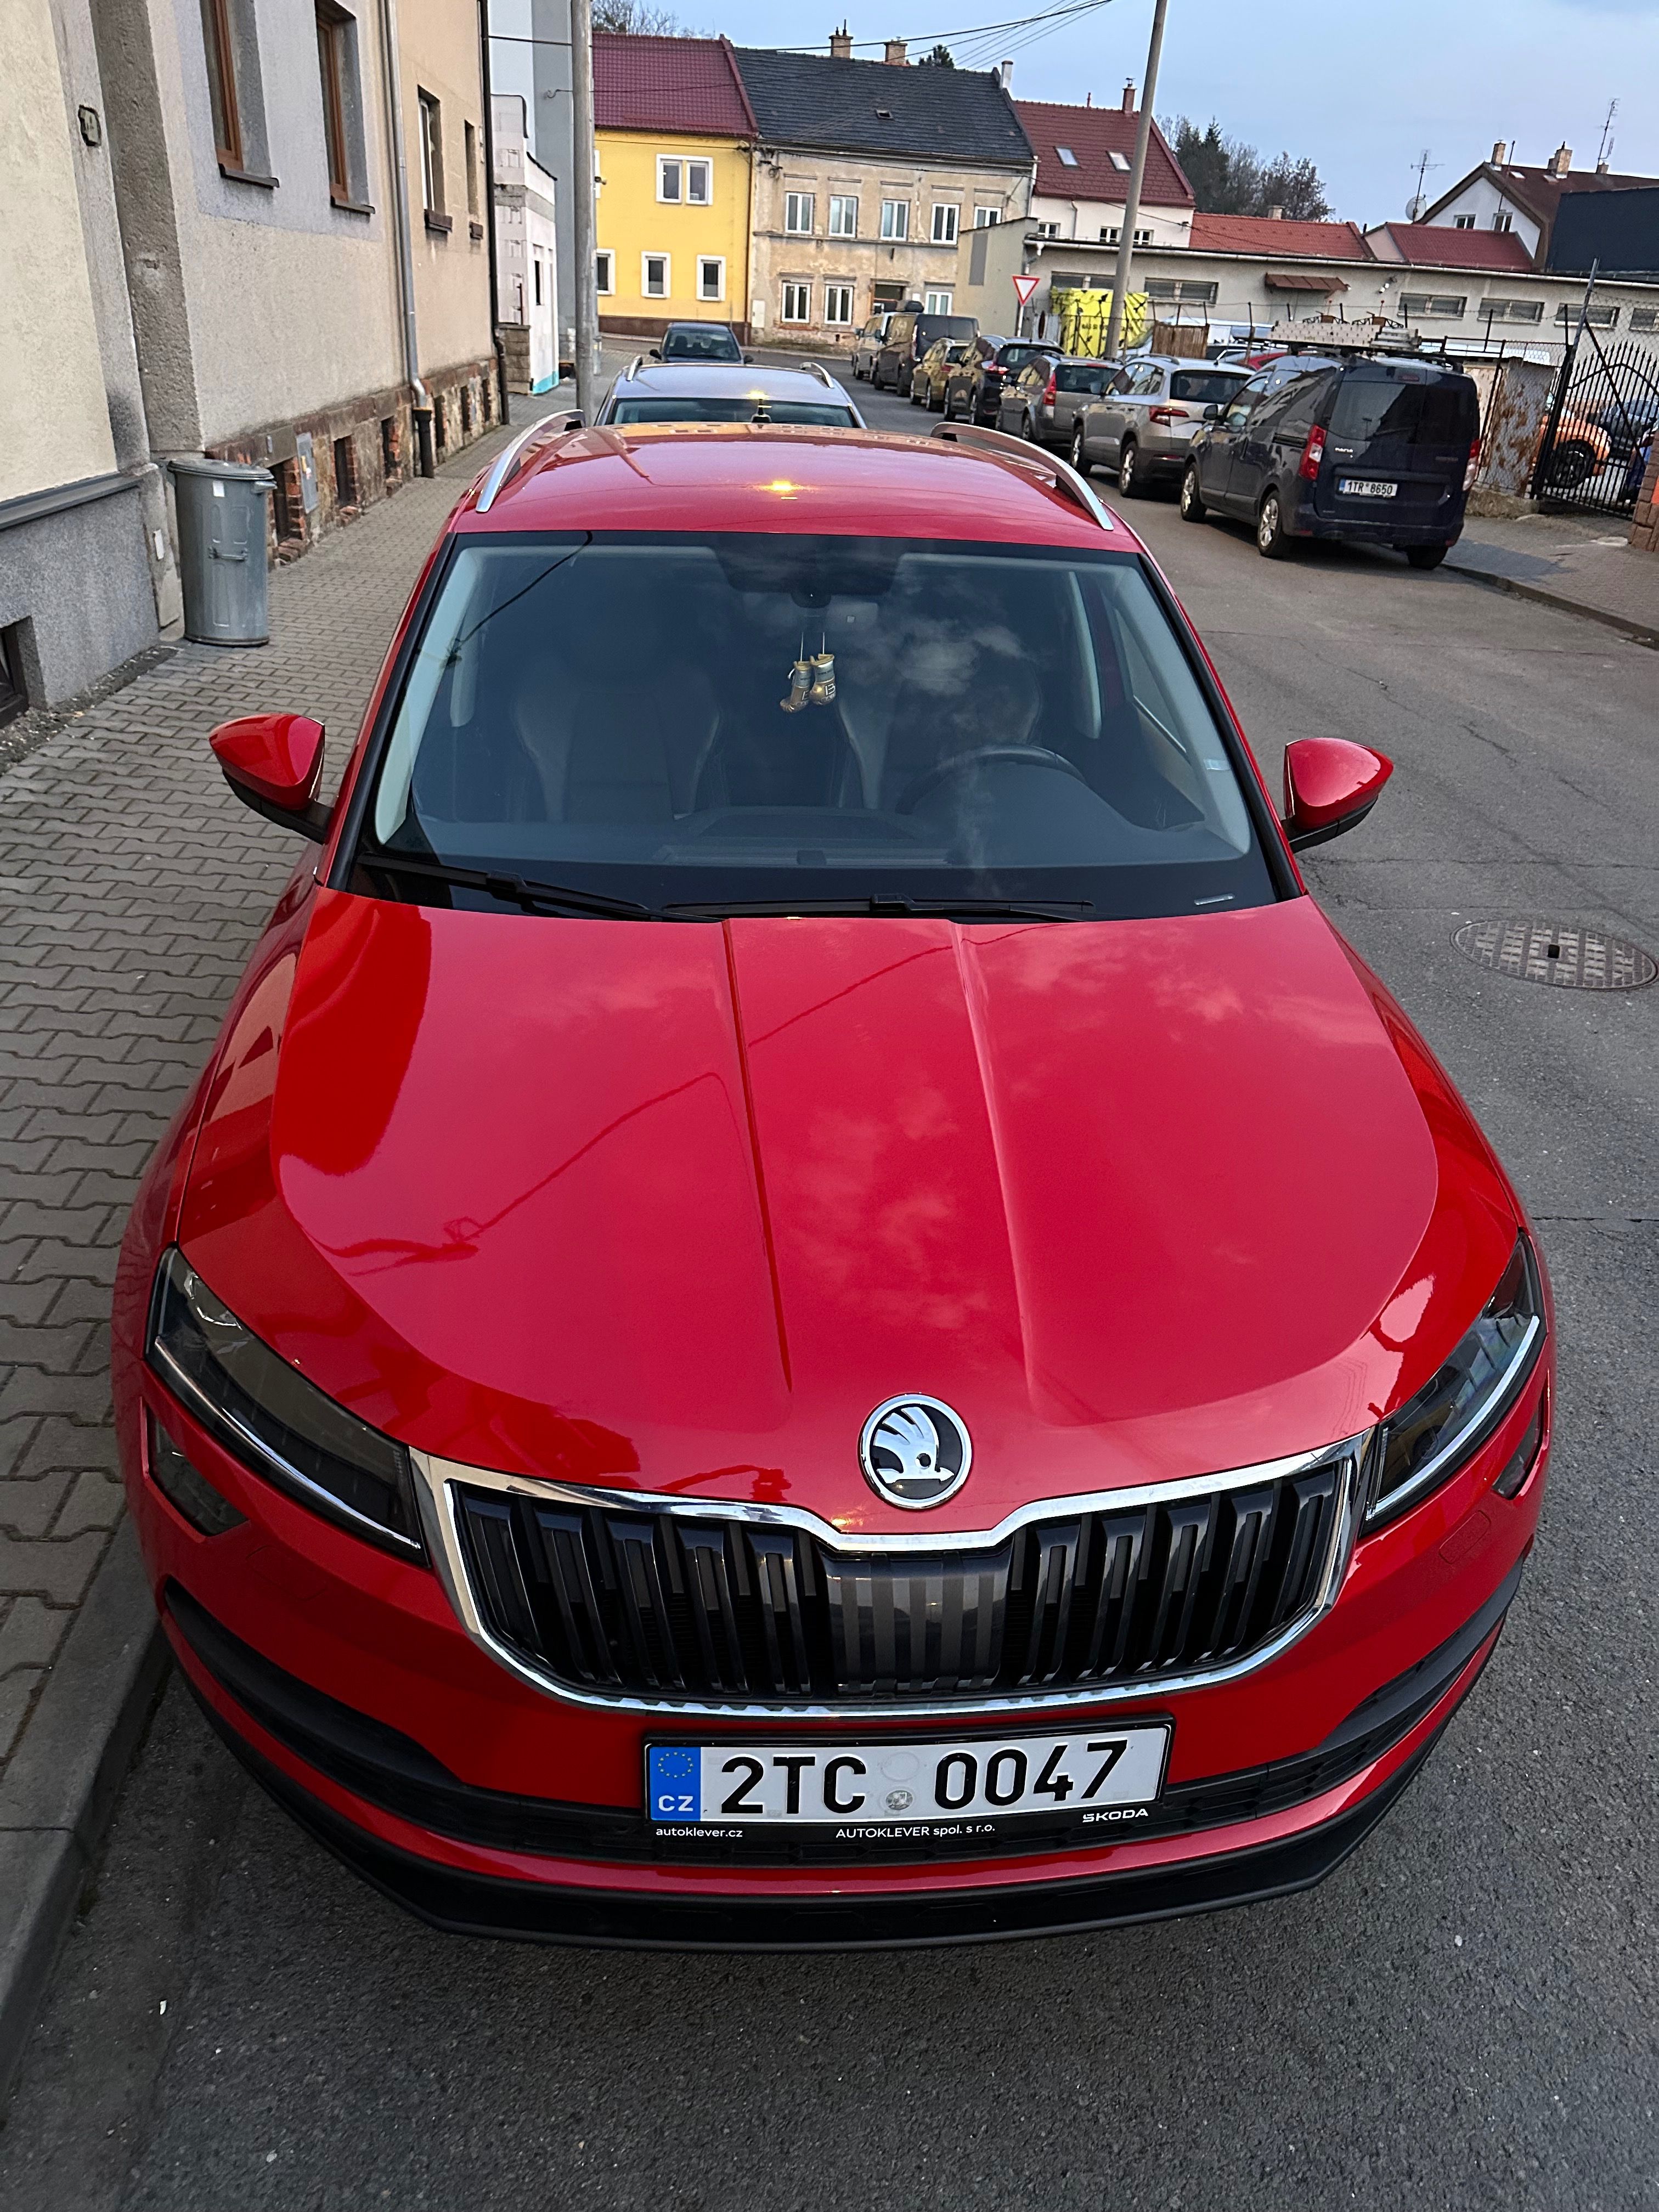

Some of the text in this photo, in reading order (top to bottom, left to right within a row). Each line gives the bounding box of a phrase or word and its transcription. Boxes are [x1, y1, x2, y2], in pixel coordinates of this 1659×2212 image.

[1348, 481, 1393, 495] 1TR 8650
[721, 1739, 1128, 1814] 2TC 0047
[658, 1795, 693, 1812] CZ
[656, 1827, 743, 1837] autoklever.cz
[836, 1824, 995, 1838] AUTOKLEVER spol. s r.o.
